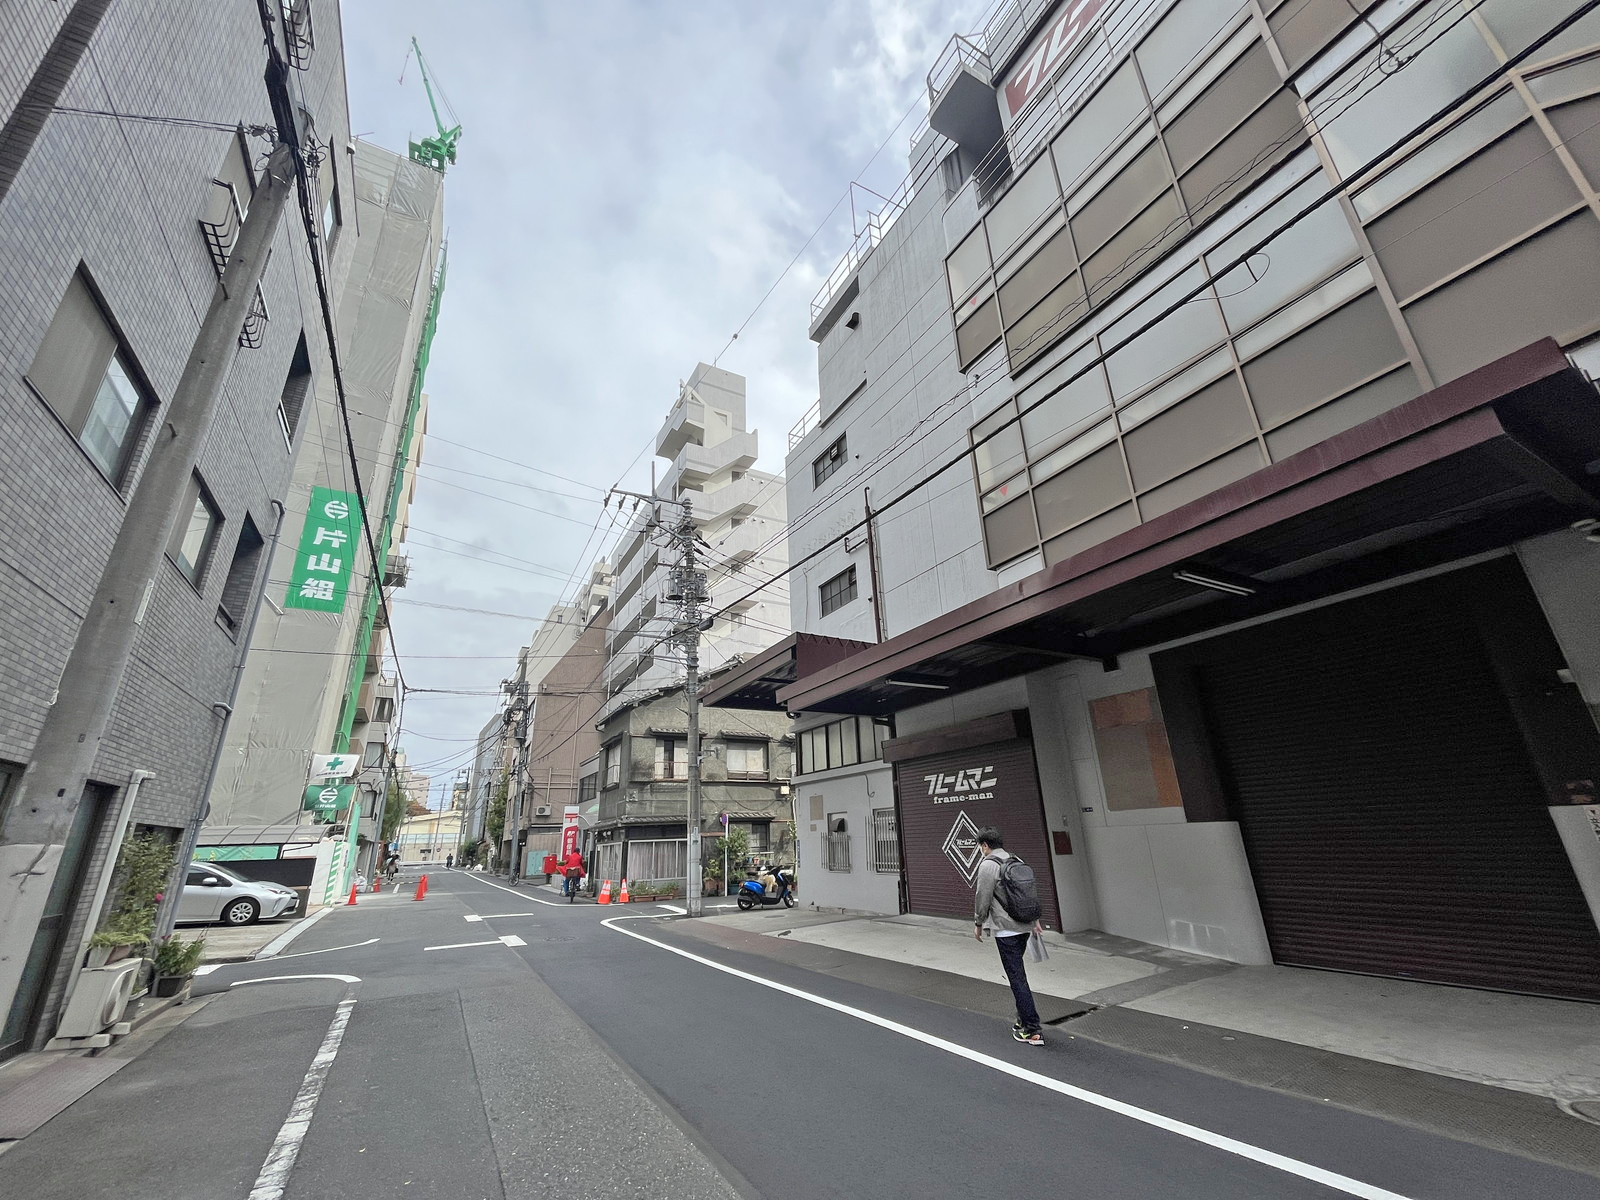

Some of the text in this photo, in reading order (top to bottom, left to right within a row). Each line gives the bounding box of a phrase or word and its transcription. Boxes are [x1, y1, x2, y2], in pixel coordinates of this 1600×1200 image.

[299, 526, 348, 601] 片山組
[923, 765, 998, 796] フレームマン
[933, 791, 994, 805] frame-man
